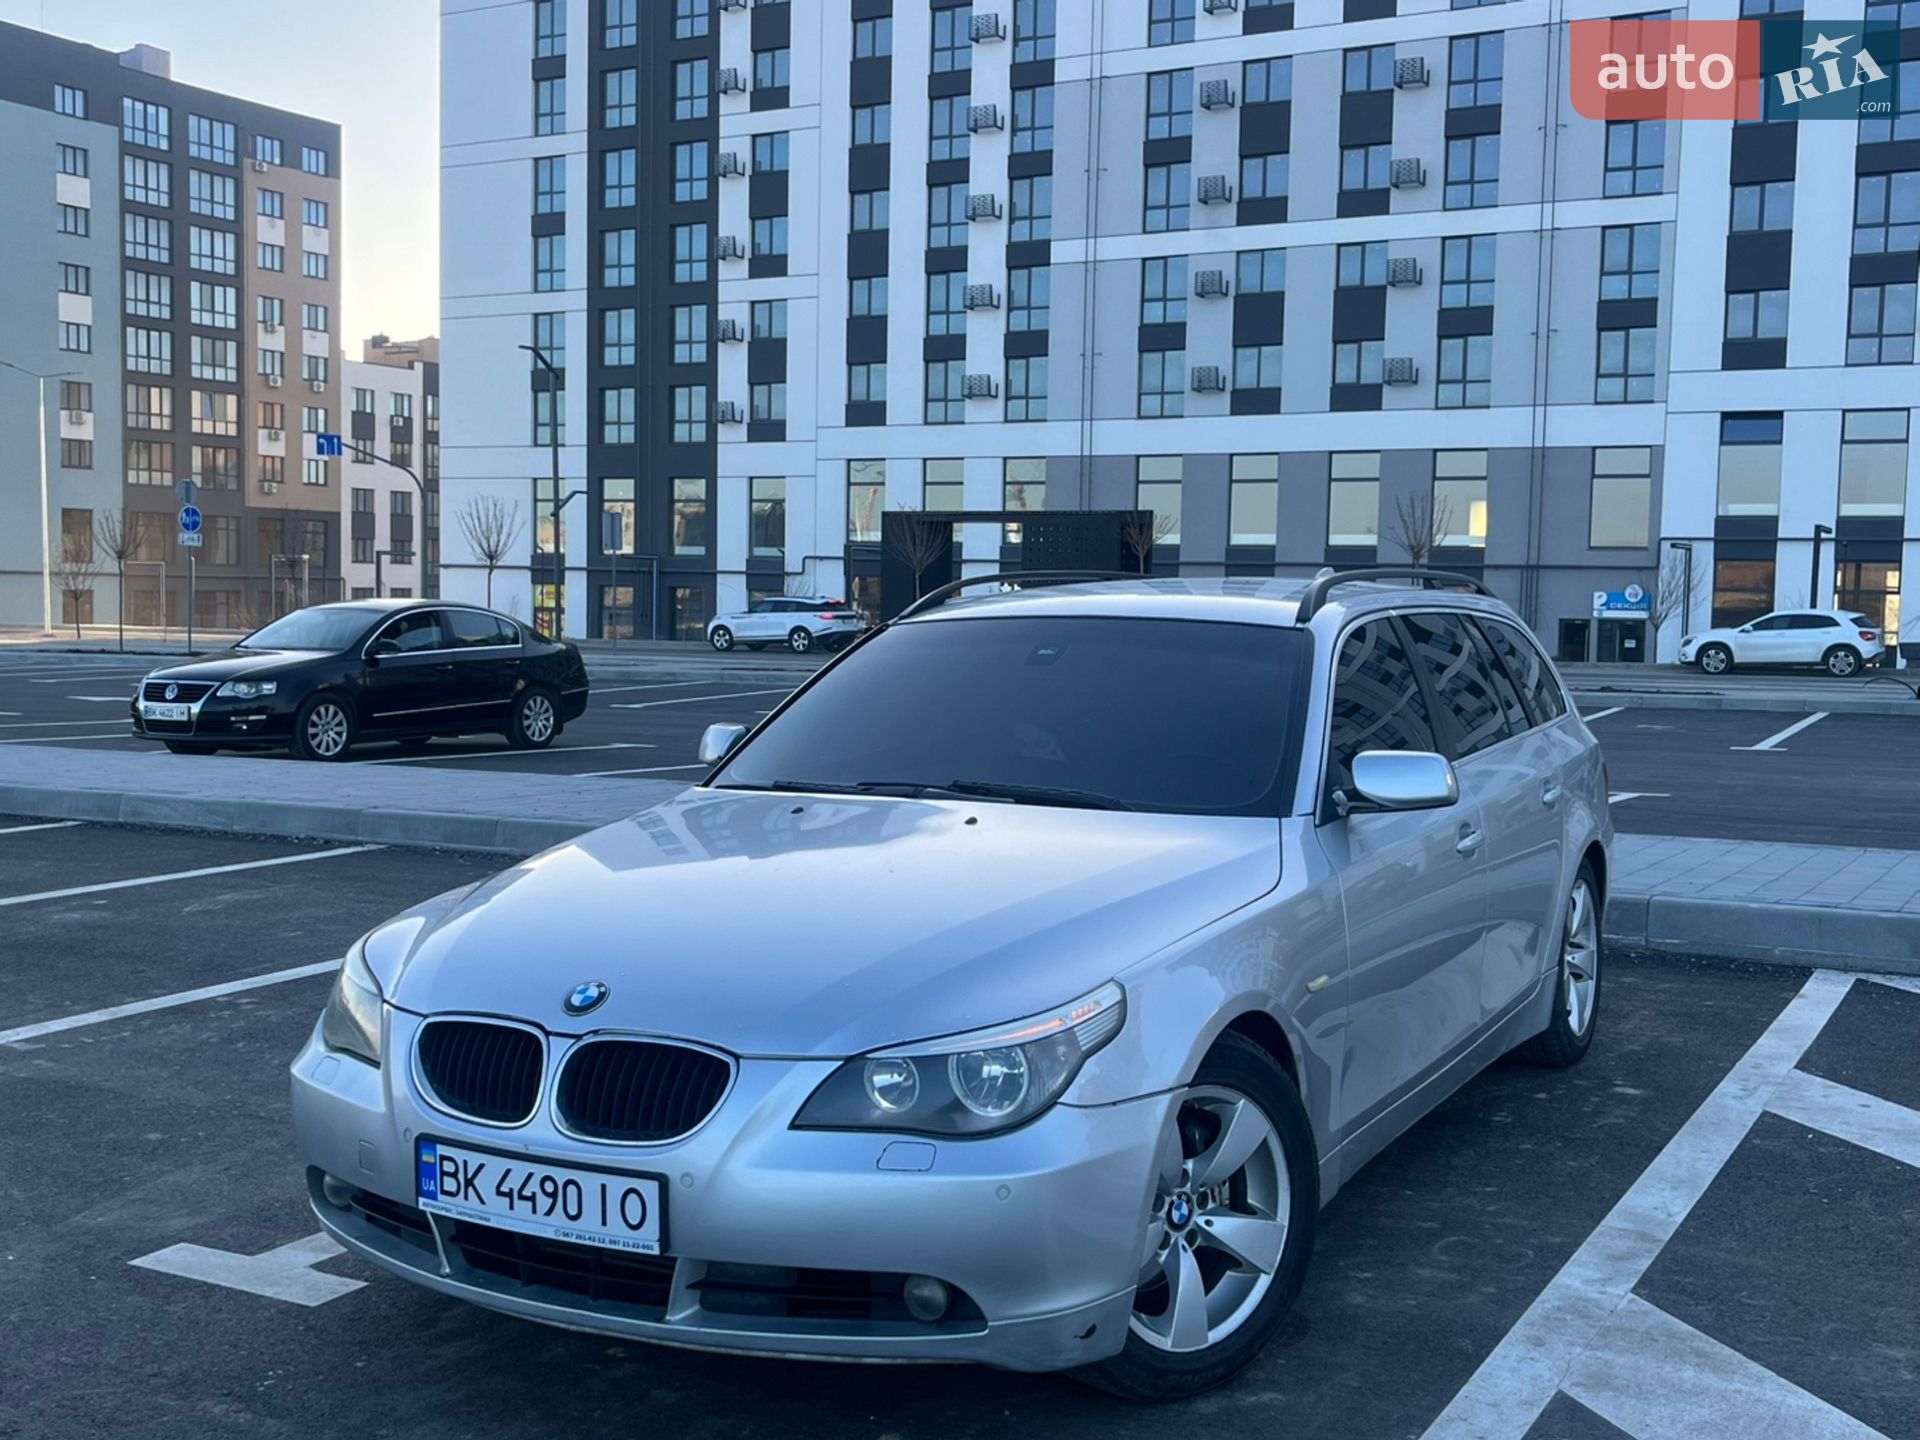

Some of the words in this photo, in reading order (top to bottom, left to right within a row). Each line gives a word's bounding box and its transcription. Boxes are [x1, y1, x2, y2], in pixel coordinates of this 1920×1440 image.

[422, 1177, 436, 1193] UA
[439, 1154, 487, 1206] BK
[495, 1168, 583, 1222] 4490
[601, 1182, 648, 1231] IO
